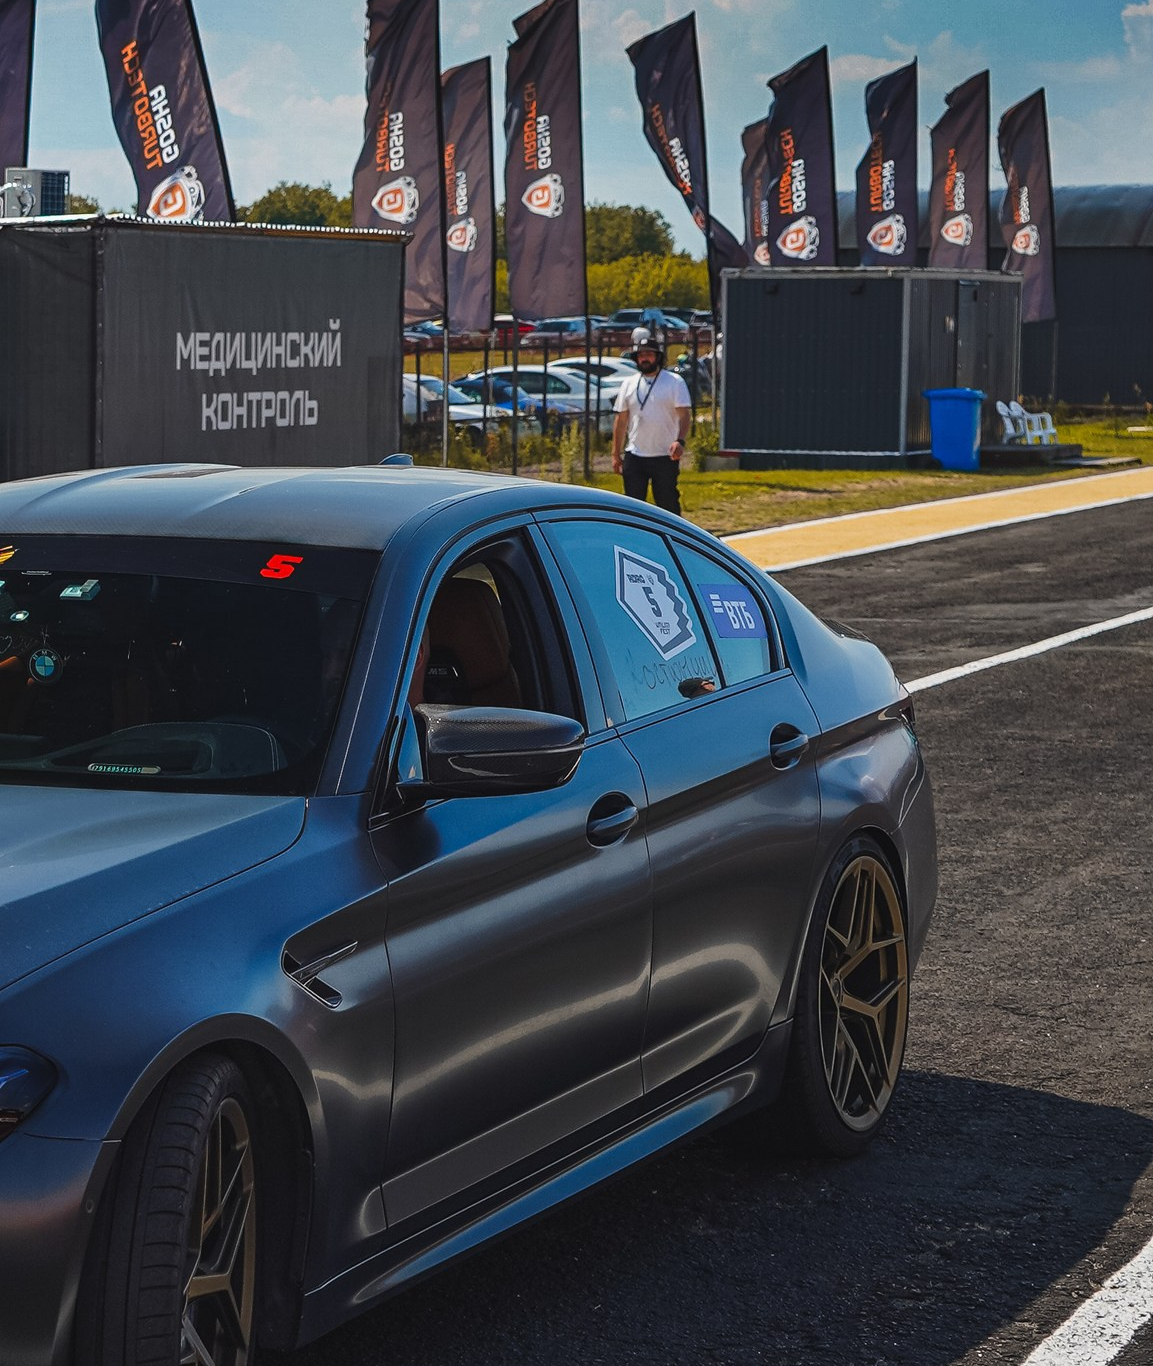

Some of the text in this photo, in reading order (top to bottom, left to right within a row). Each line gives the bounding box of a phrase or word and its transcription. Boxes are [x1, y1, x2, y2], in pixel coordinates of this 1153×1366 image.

[175, 319, 342, 377] МЕДИЦИНСКИЙ
[200, 389, 319, 431] КОНТРОЛЬ
[260, 554, 304, 579] 5
[641, 586, 663, 618] 5
[723, 601, 756, 630] ВТБ
